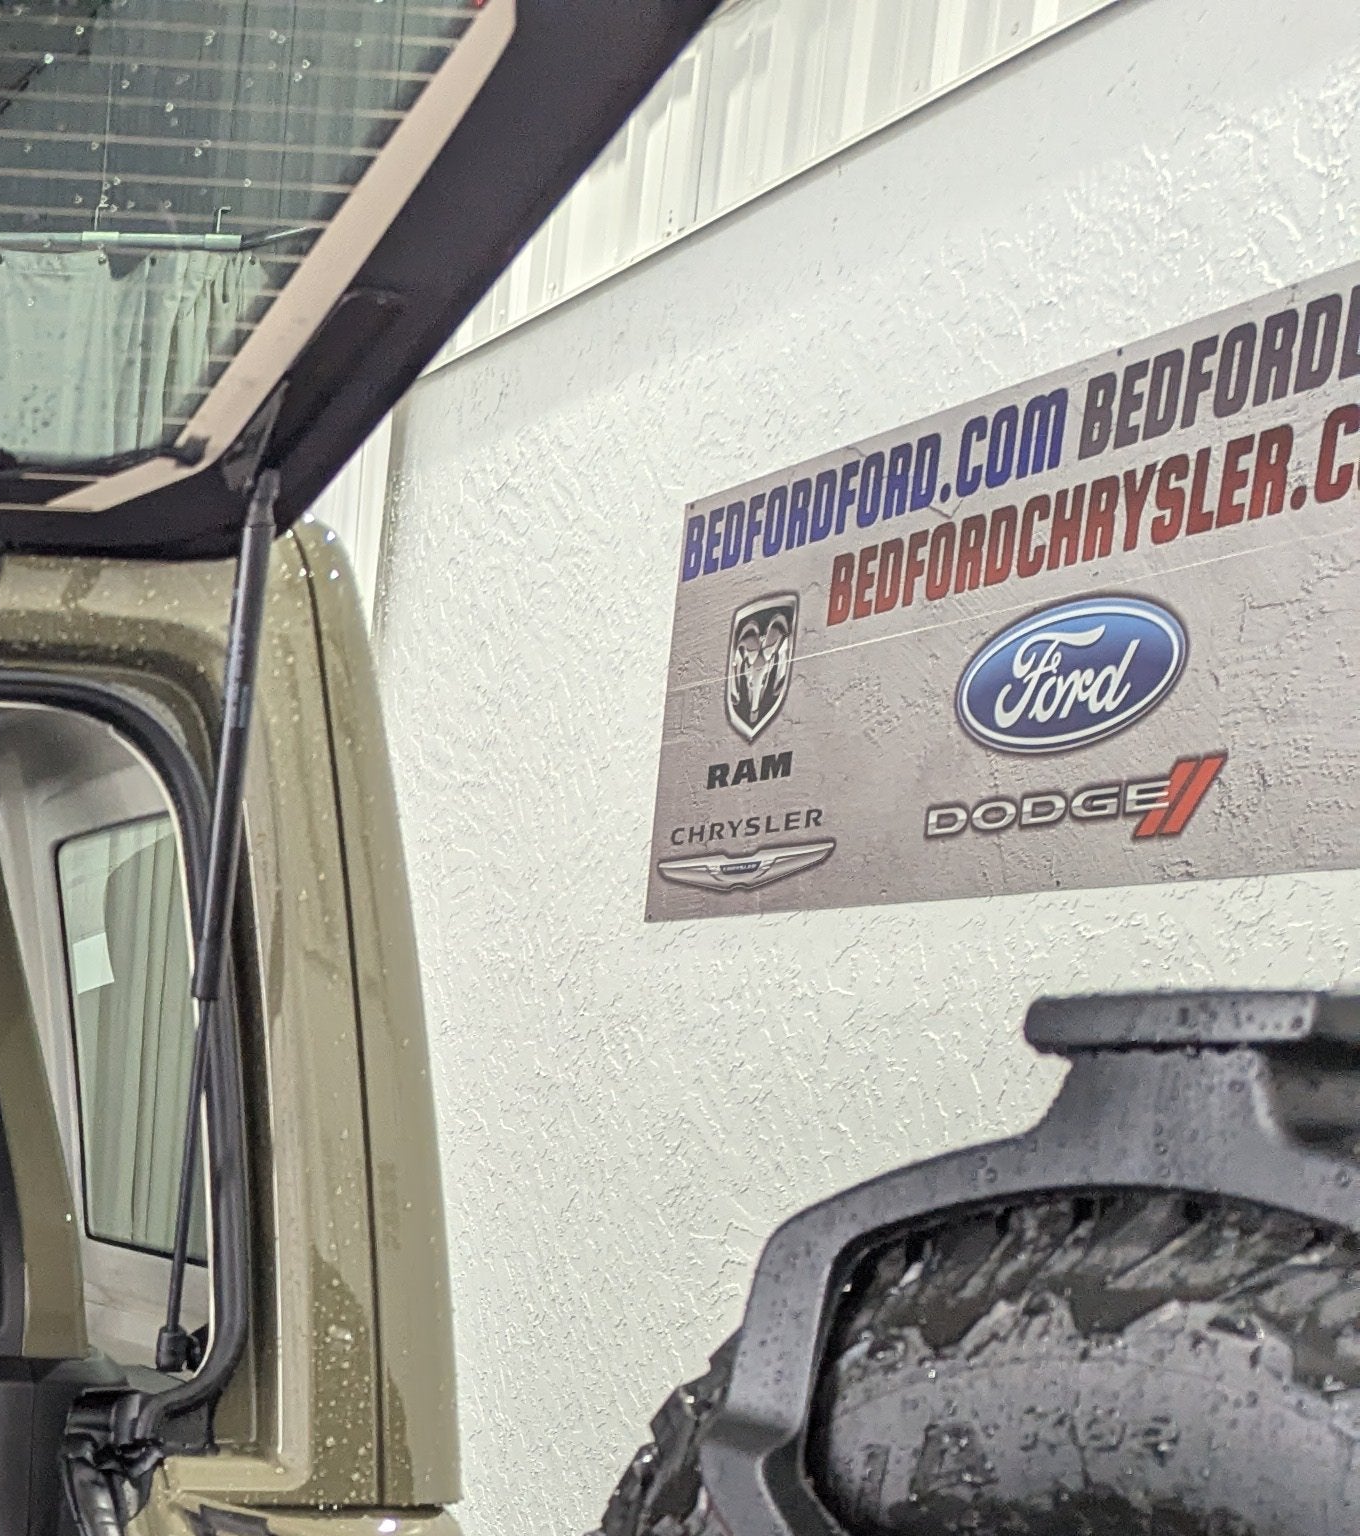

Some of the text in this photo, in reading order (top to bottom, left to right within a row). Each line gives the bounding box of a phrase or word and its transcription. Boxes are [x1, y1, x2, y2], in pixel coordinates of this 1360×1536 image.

[681, 387, 1068, 582] BEDFORDFORD.COM
[826, 402, 1360, 627] BEDFORDCHRYSLER.C
[994, 624, 1141, 729] Ford
[707, 751, 793, 790] RAM
[926, 780, 1171, 837] DODGE
[670, 808, 823, 846] CHRYSLER
